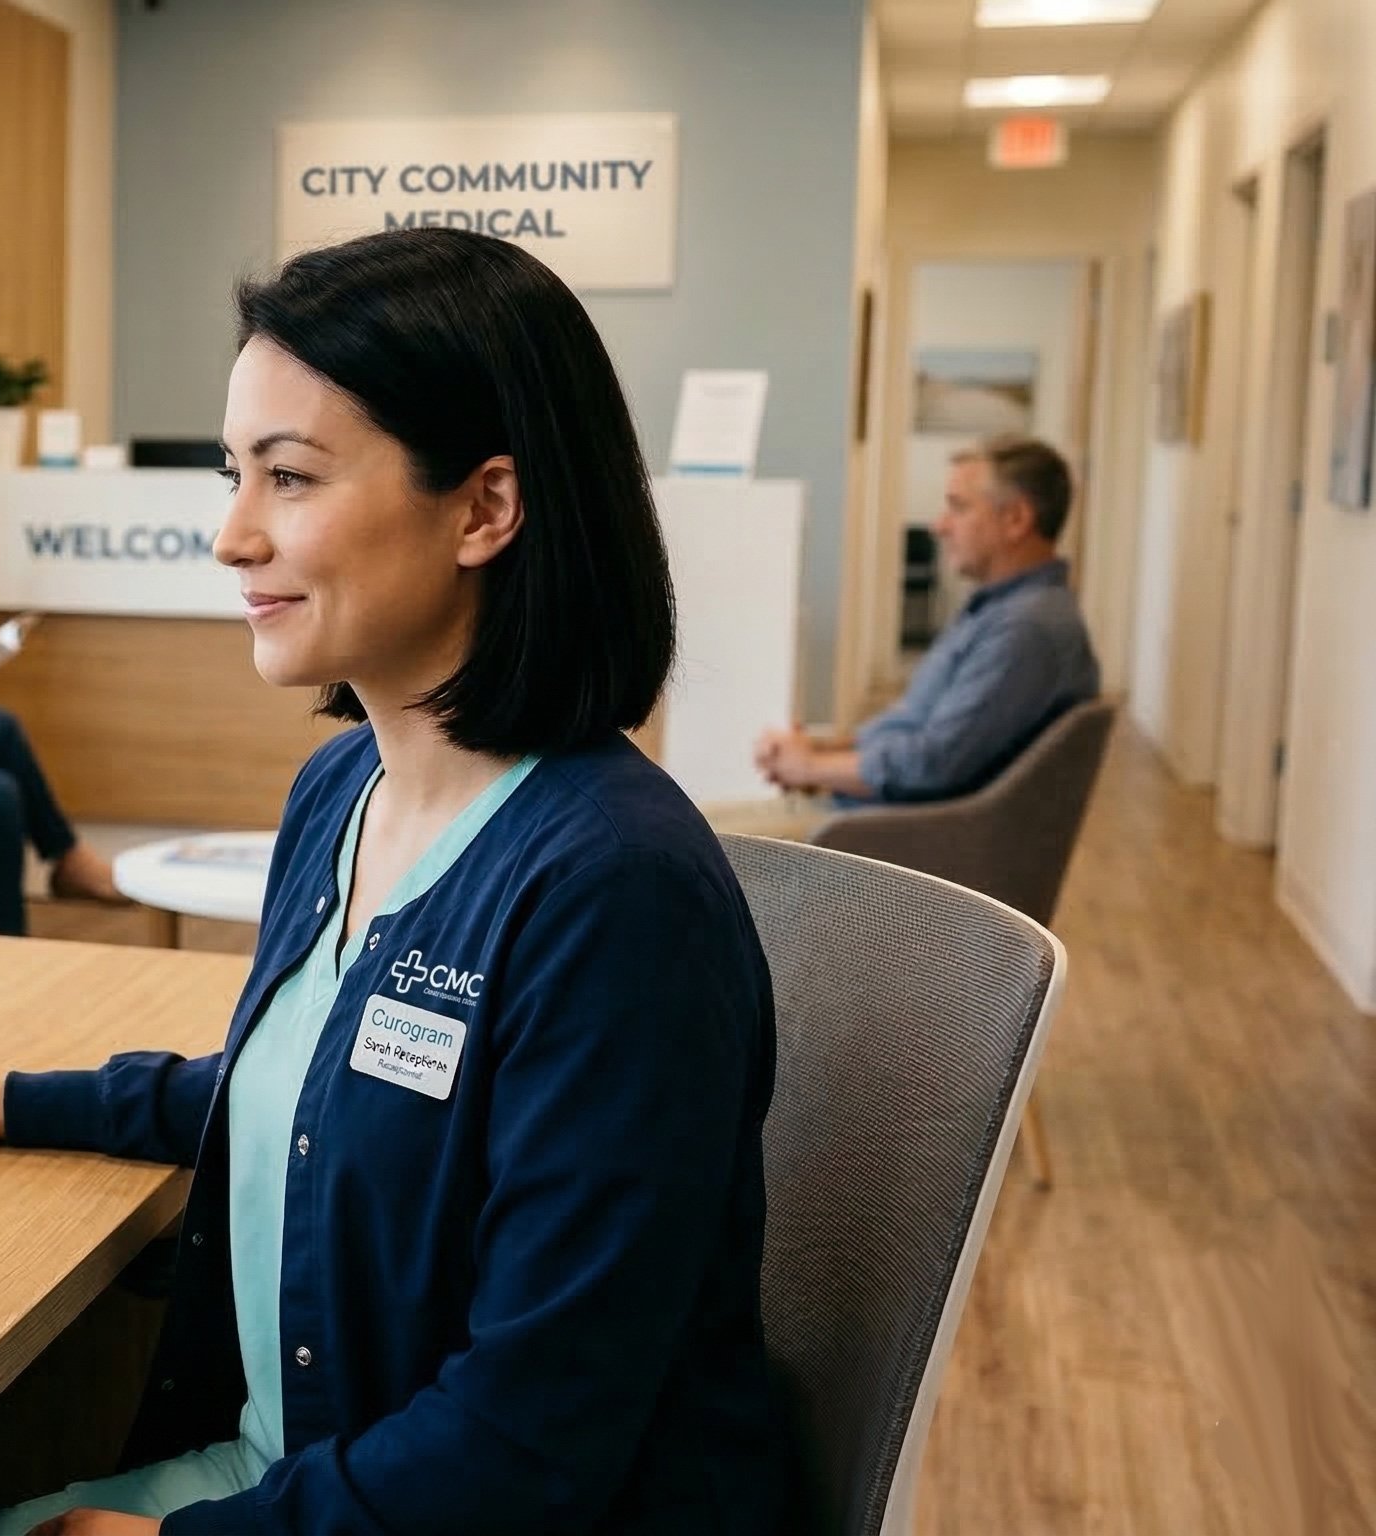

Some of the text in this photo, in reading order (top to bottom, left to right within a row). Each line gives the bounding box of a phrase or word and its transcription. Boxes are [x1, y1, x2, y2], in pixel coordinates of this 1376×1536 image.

[301, 160, 653, 196] CITY COMMUNITY
[384, 208, 567, 239] MEDICAL
[430, 965, 484, 997] CMC
[372, 1008, 453, 1048] Curogram
